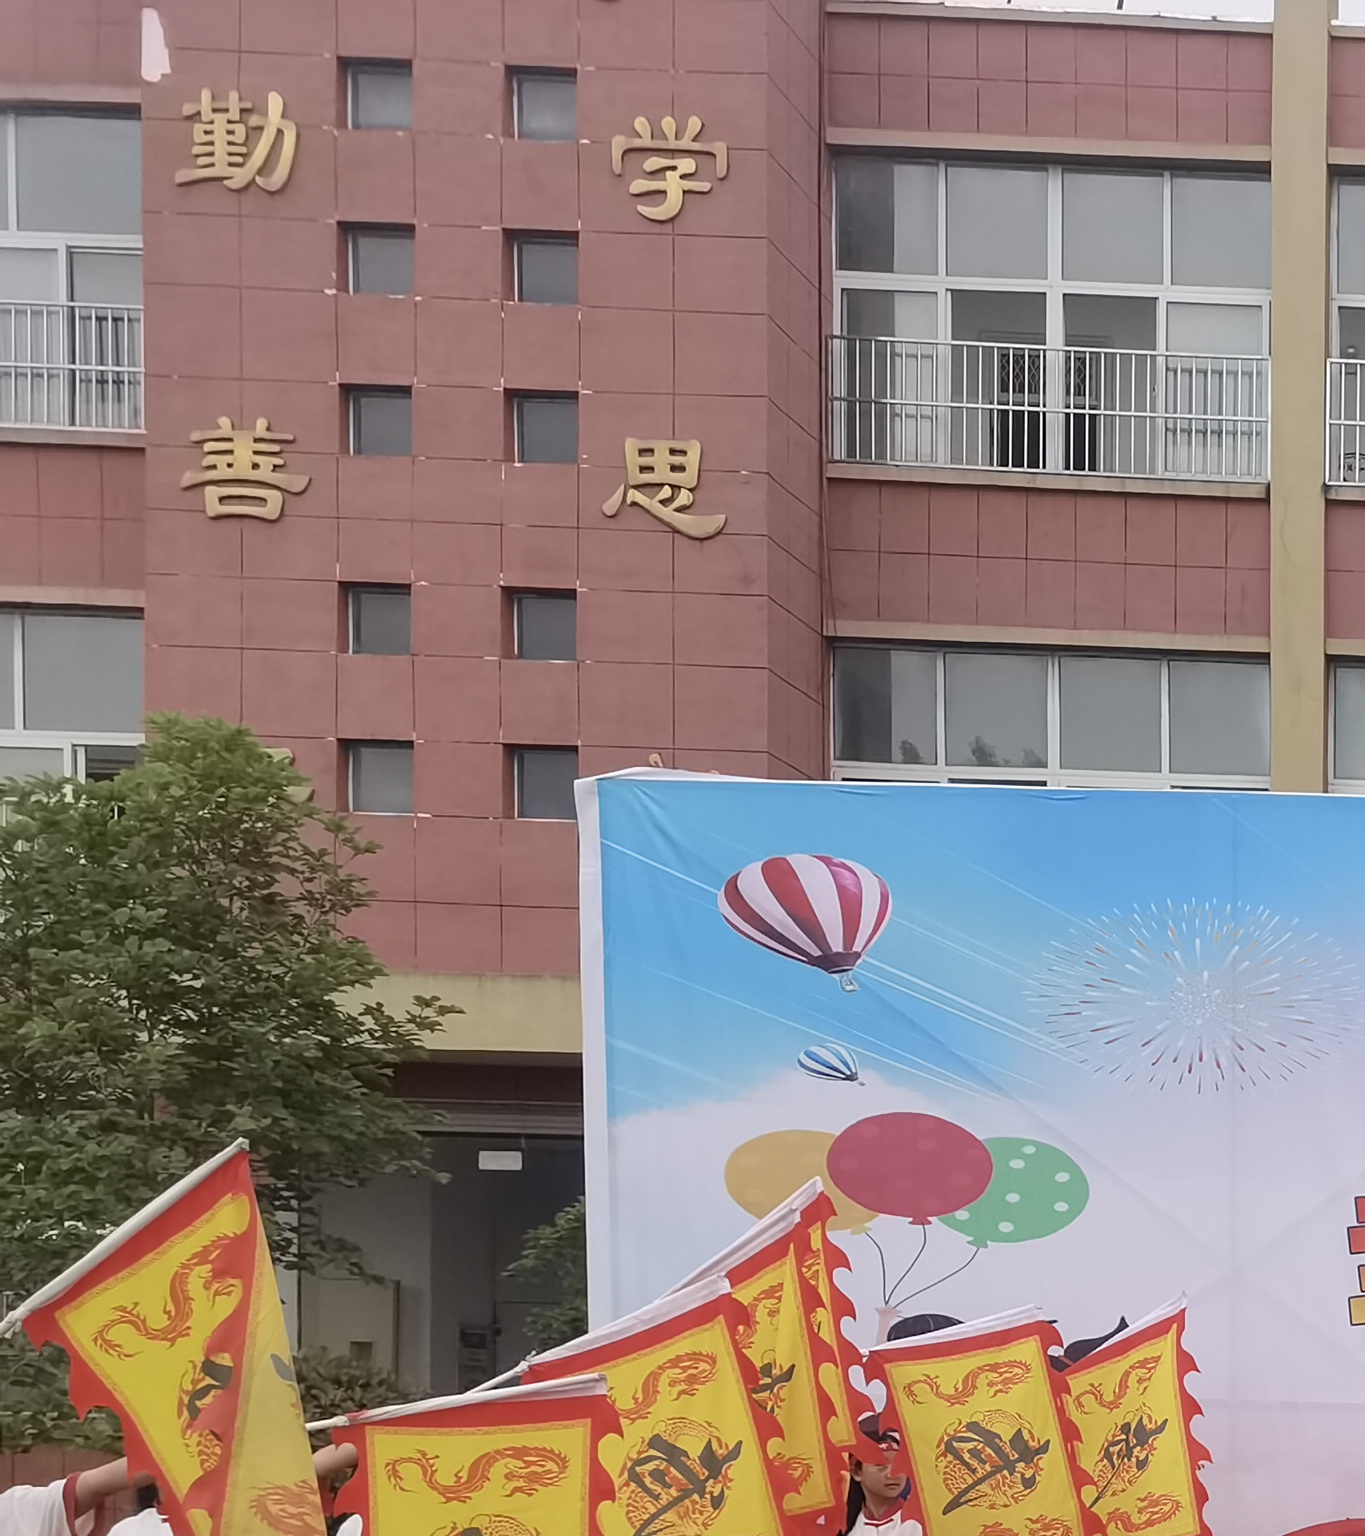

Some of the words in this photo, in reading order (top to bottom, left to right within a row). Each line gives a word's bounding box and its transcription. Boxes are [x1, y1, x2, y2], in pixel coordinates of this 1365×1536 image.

[173, 86, 300, 193] 勤
[609, 114, 730, 223] 学
[180, 415, 311, 523] 善
[602, 437, 728, 541] 思
